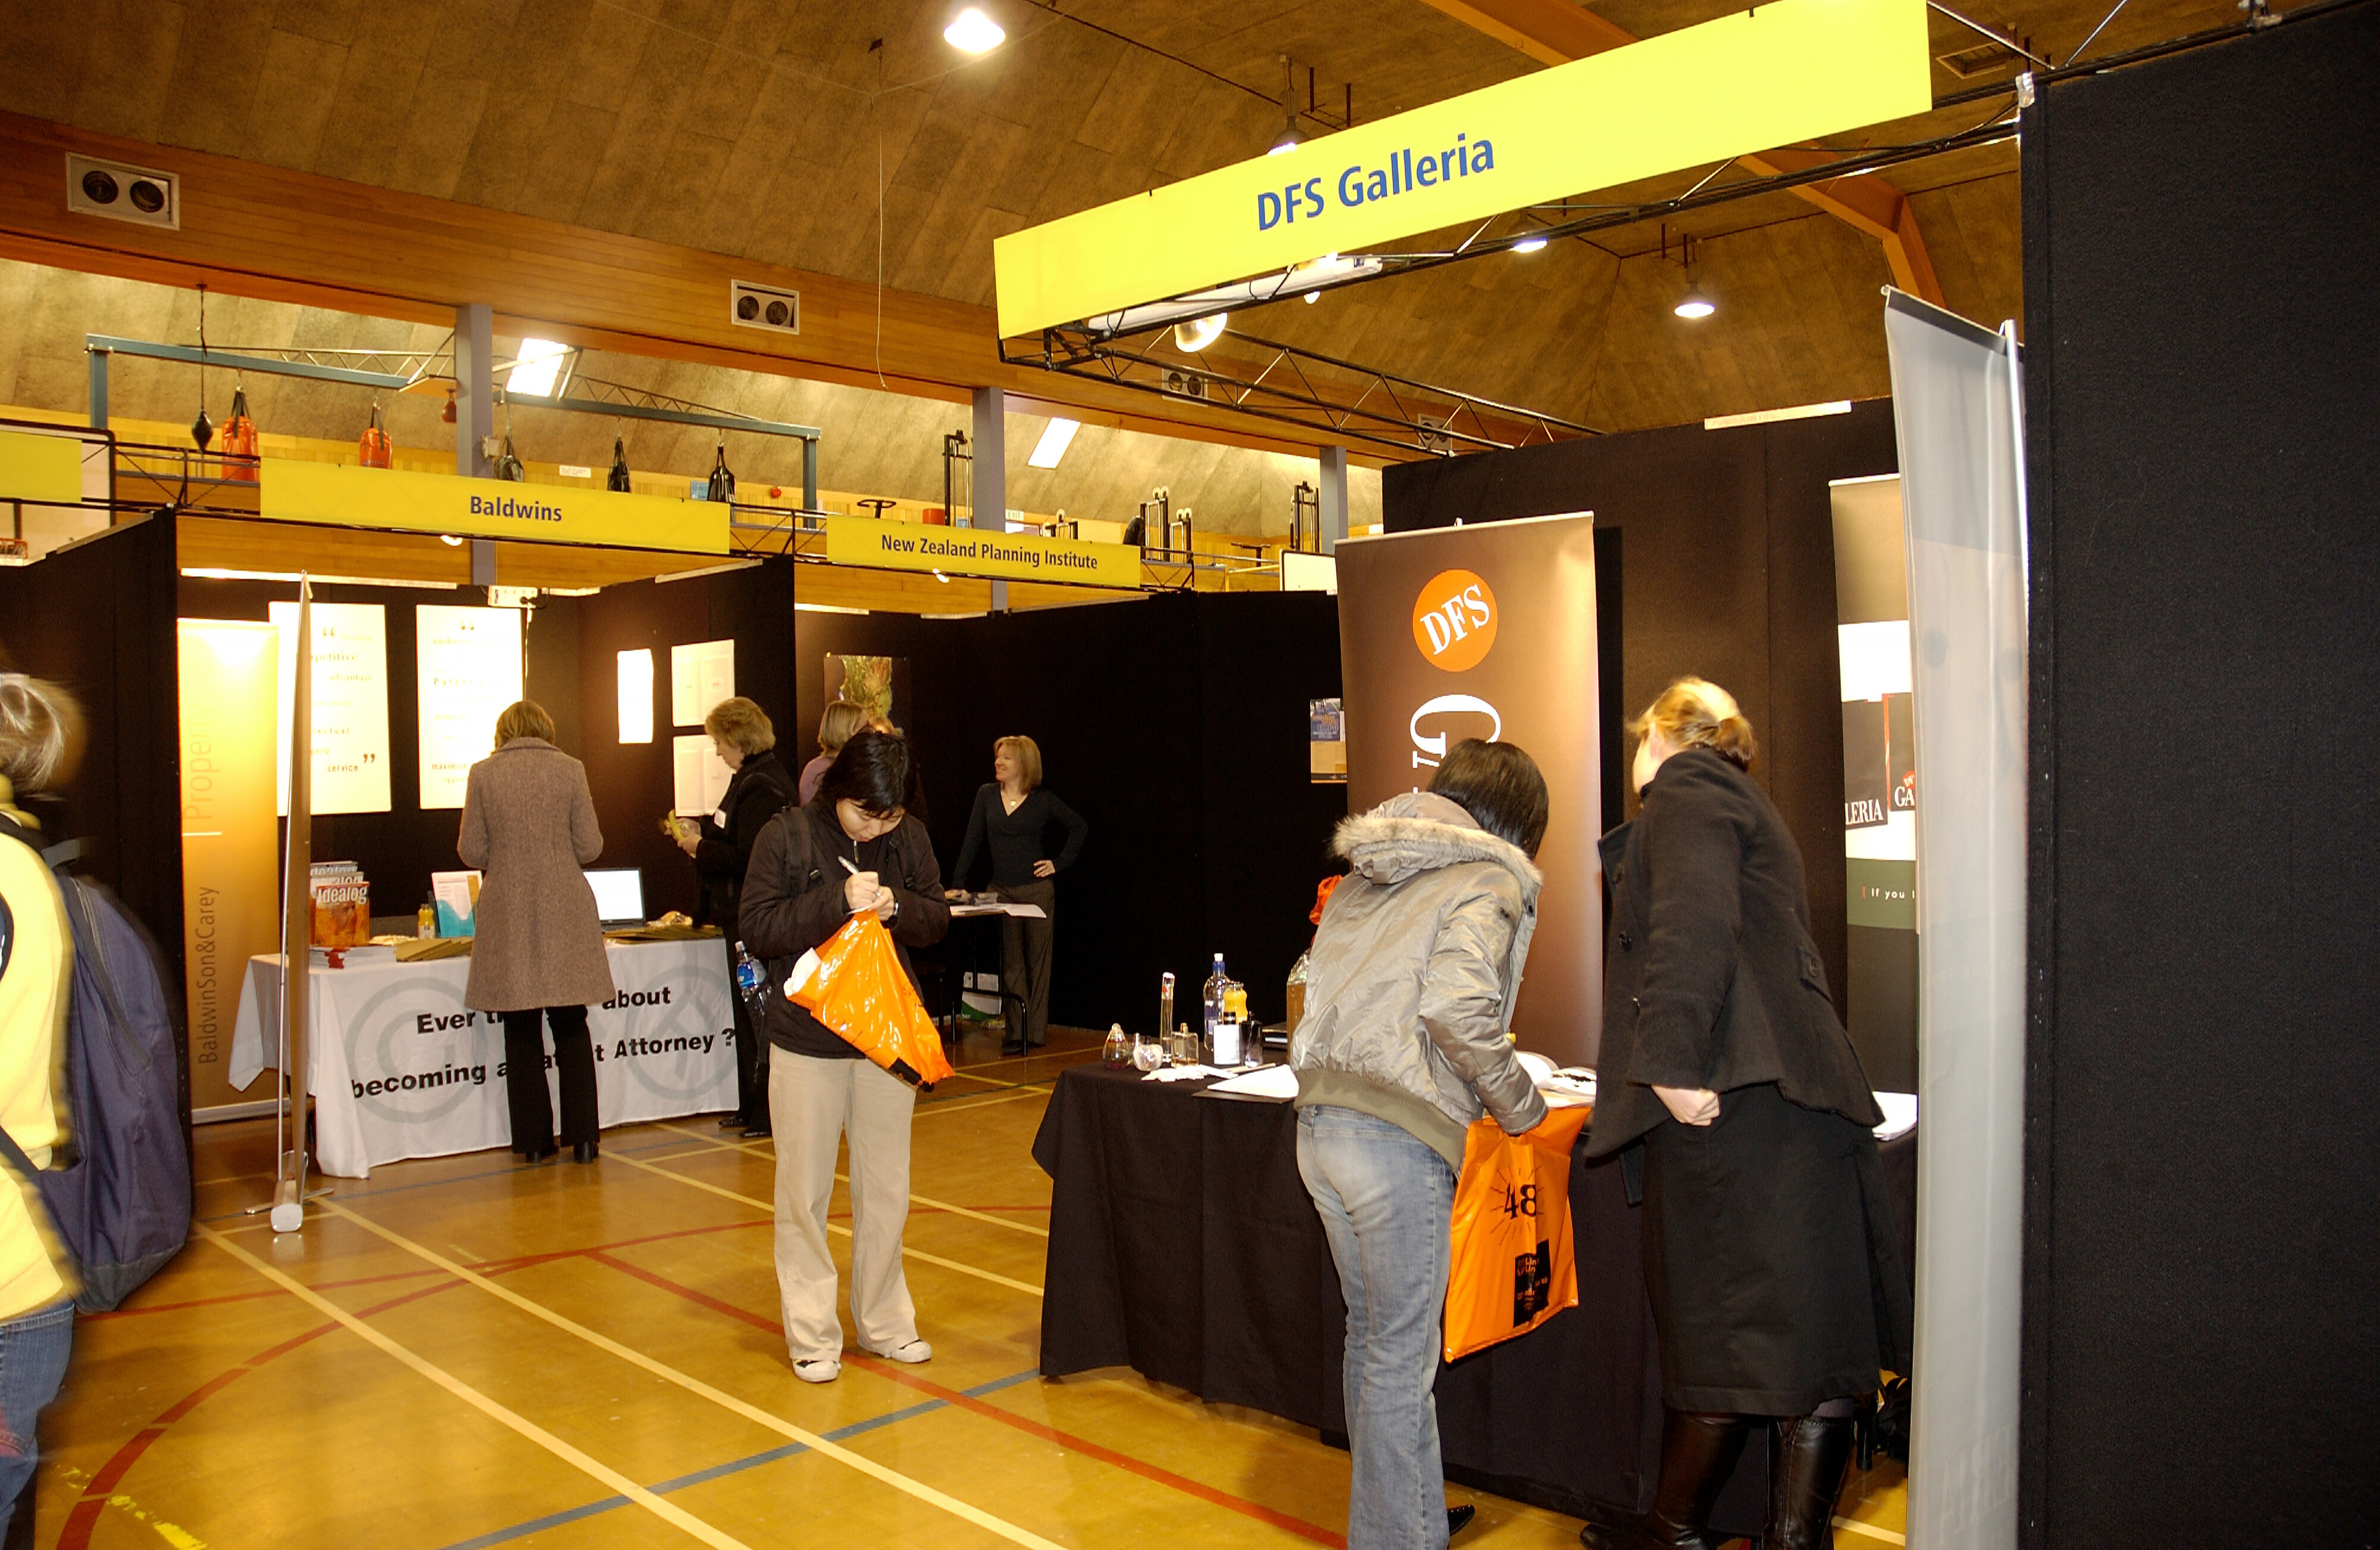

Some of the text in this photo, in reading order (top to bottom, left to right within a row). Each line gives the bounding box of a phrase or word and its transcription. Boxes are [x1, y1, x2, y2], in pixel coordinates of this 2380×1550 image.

[1258, 133, 1494, 231] DFS Galleria
[470, 496, 562, 522] Baldwins
[881, 534, 1097, 569] New Zealand Planning Institute
[1420, 584, 1490, 655] DFS
[183, 704, 221, 819] Property
[1845, 798, 1884, 825] LERIA
[317, 885, 368, 904] Idealog
[1885, 891, 1905, 901] you
[196, 887, 219, 1064] BaldwinSon&Carey
[417, 1012, 475, 1035] Ever
[352, 1062, 486, 1099] becoming
